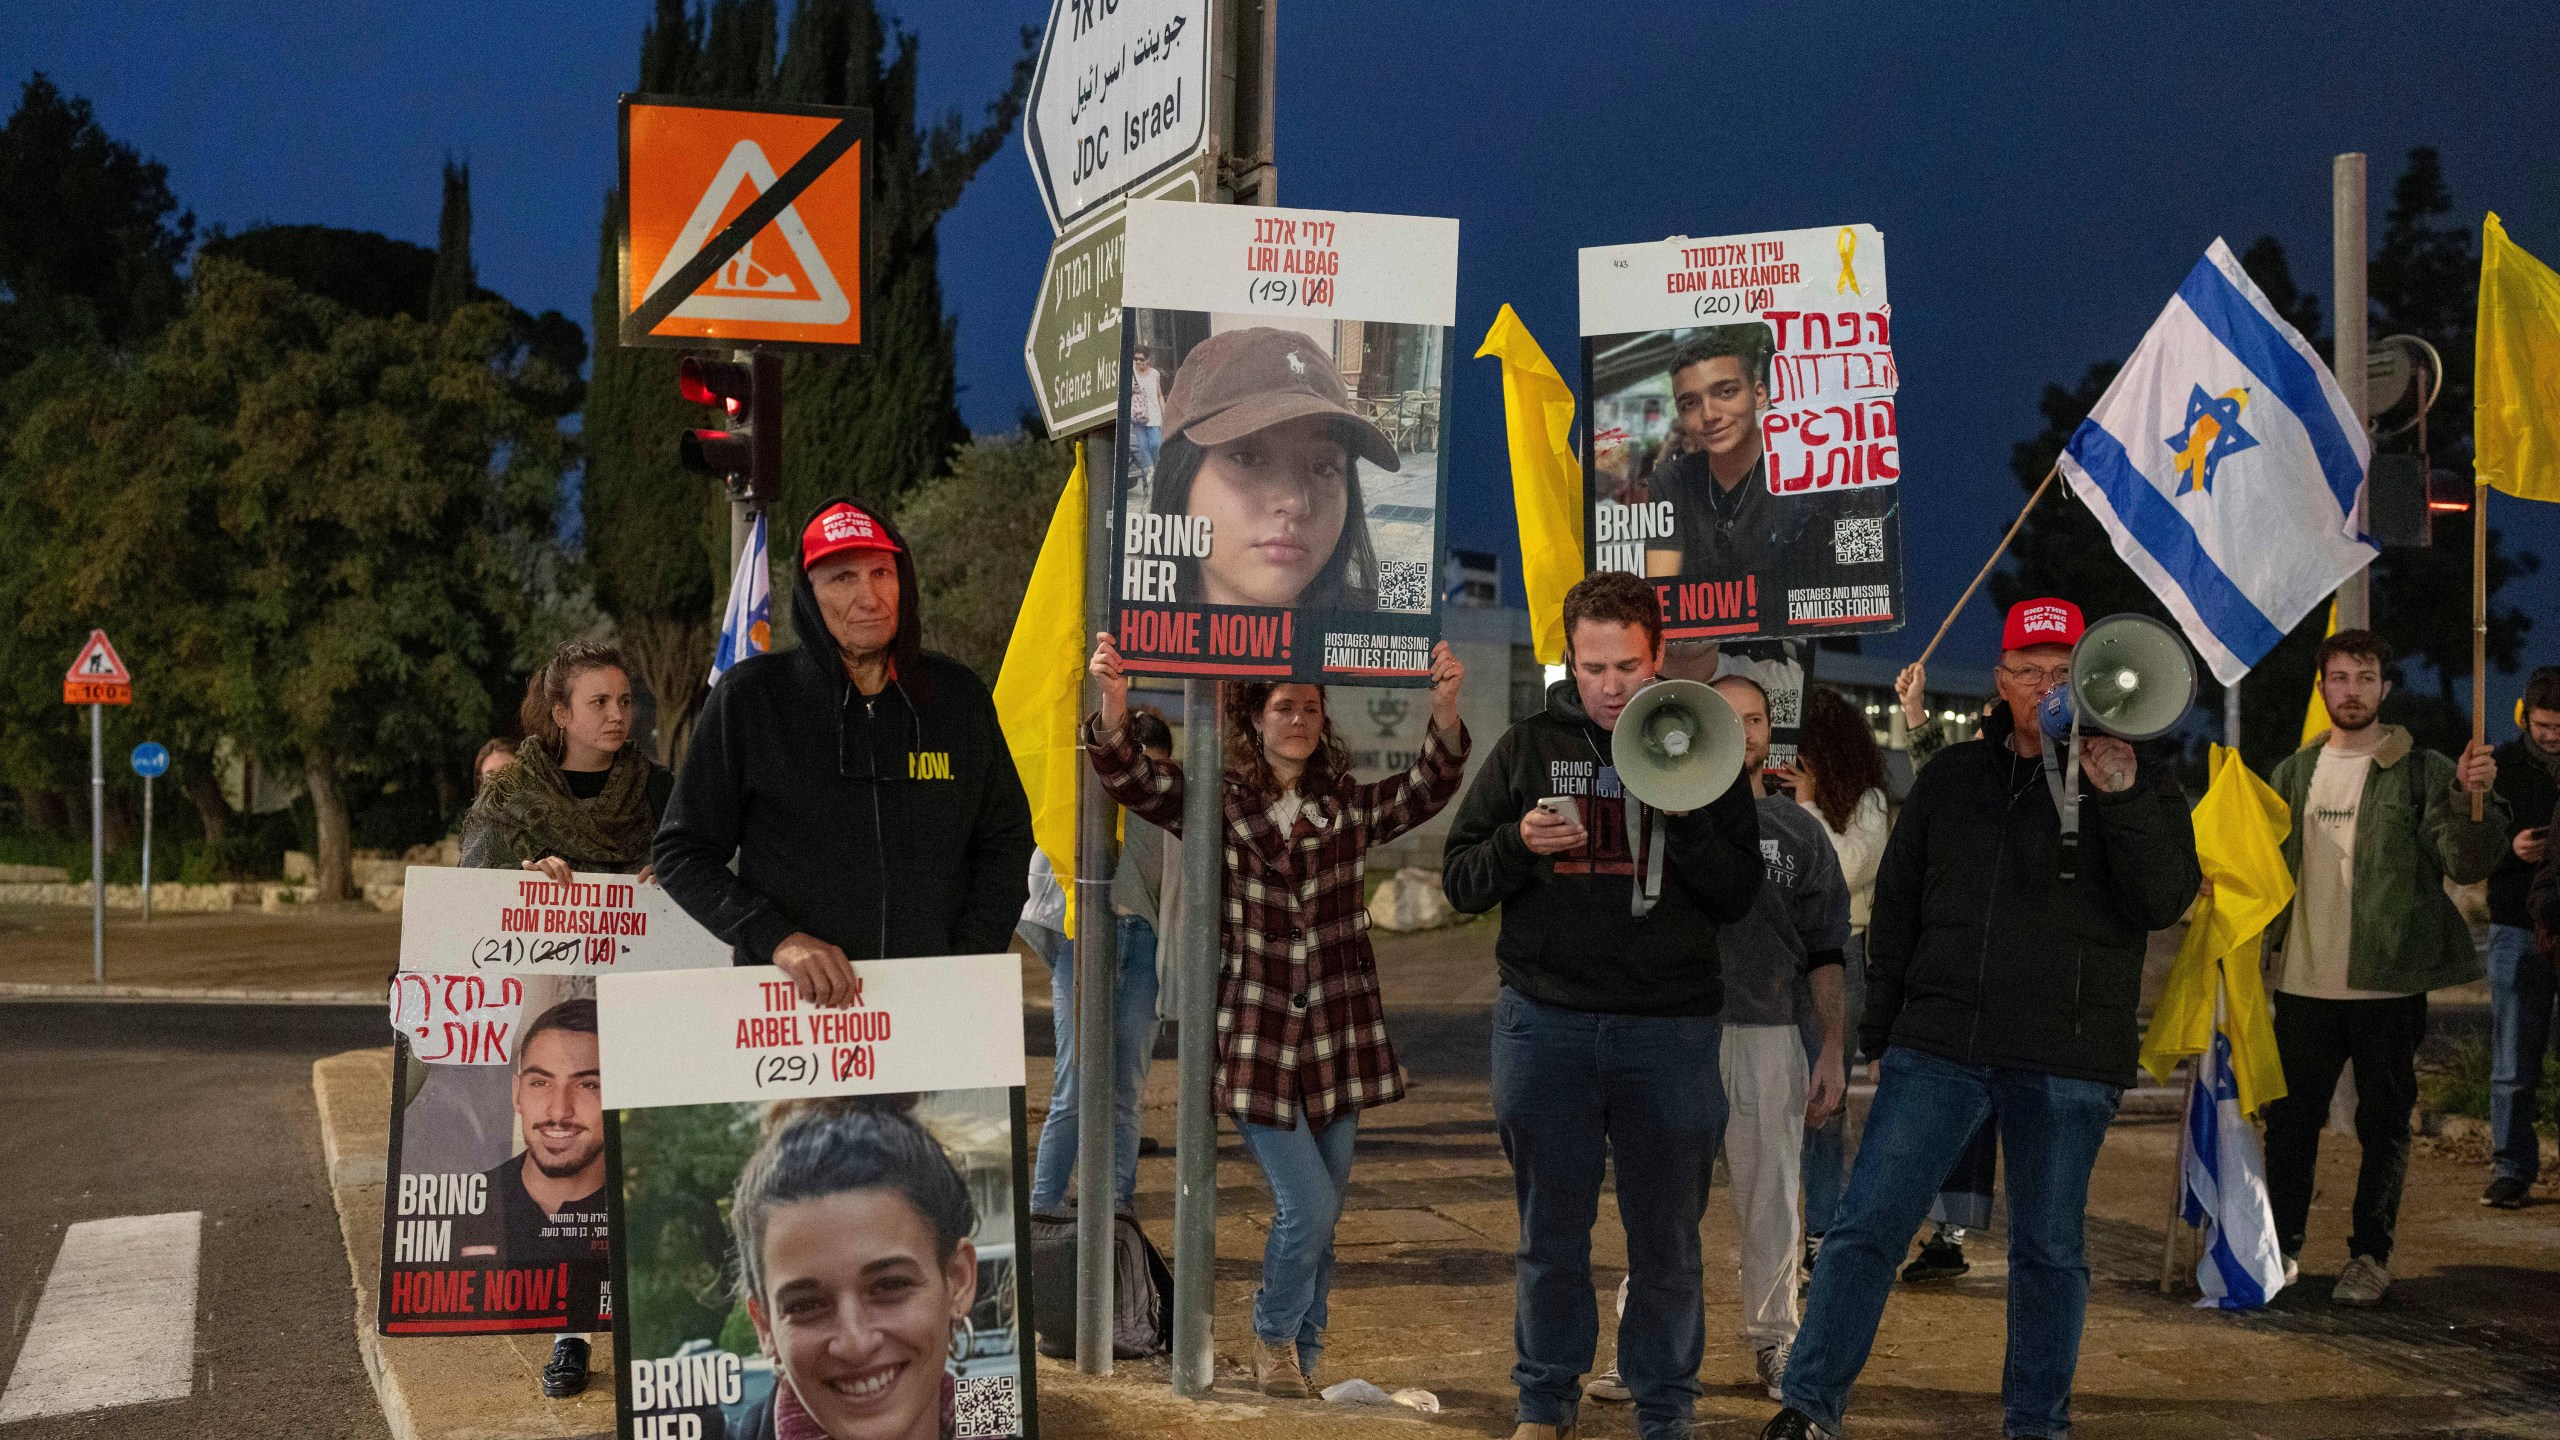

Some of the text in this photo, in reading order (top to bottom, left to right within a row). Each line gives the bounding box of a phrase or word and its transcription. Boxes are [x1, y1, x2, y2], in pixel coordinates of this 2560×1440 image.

[1133, 15, 1187, 66] جوينت
[1073, 76, 1182, 186] JDC Israel
[1253, 217, 1335, 247] לירי אלבג
[1247, 246, 1339, 276] LIRI ALBAG
[1680, 240, 1784, 269] עידן אלכסנדר
[1055, 232, 1125, 314] זיאון המדע
[1667, 263, 1801, 294] EDAN ALEXANDER
[1249, 276, 1335, 307] (19) (18)
[1694, 293, 1740, 318] (20)
[1058, 311, 1091, 362] العلوم
[1762, 311, 1889, 350] הפחד
[1054, 355, 1117, 409] Science Mus
[1763, 400, 1897, 452] הורגים
[1769, 443, 1900, 494] אותנו
[844, 511, 871, 521] THIS
[1595, 501, 1675, 542] BRING
[824, 525, 873, 542] WAR
[1124, 512, 1213, 557] BRING
[1596, 540, 1646, 579] HIM
[1122, 559, 1177, 603] HER
[1788, 584, 1890, 602] HOSTAGES AND MISSING
[1679, 574, 1758, 622] NOW!
[1788, 597, 1891, 620] FAMILIES FORUM
[2023, 605, 2068, 617] END THIS
[1119, 609, 1293, 659] HOME NOW!
[1324, 632, 1430, 651] HOSTAGES AND MISSING
[2023, 619, 2067, 634] WAR
[1324, 647, 1429, 671] FAMILIES FORUM
[84, 685, 117, 698] 100
[1769, 743, 1798, 755] MISSING
[908, 751, 954, 780] NOW.
[1551, 760, 1593, 777] BRING
[1551, 777, 1587, 795] THEM
[519, 880, 634, 908] רום ברסלבסקי
[501, 907, 647, 936] ROM BRASLAVSKI
[472, 936, 524, 969] (21)
[395, 974, 523, 1024] תחזירו
[759, 981, 804, 1012] הוד
[415, 1021, 509, 1064] אותי
[735, 1011, 891, 1049] ARBEL YEHOUD
[755, 1045, 875, 1088] (29) (28)
[397, 1173, 488, 1216] BRING
[561, 1227, 577, 1237] תמר
[576, 1212, 589, 1223] של
[579, 1227, 588, 1238] בן
[394, 1219, 452, 1263] HIM
[391, 1270, 477, 1314] HOME
[483, 1262, 568, 1312] NOW!
[630, 1352, 742, 1412] BRING
